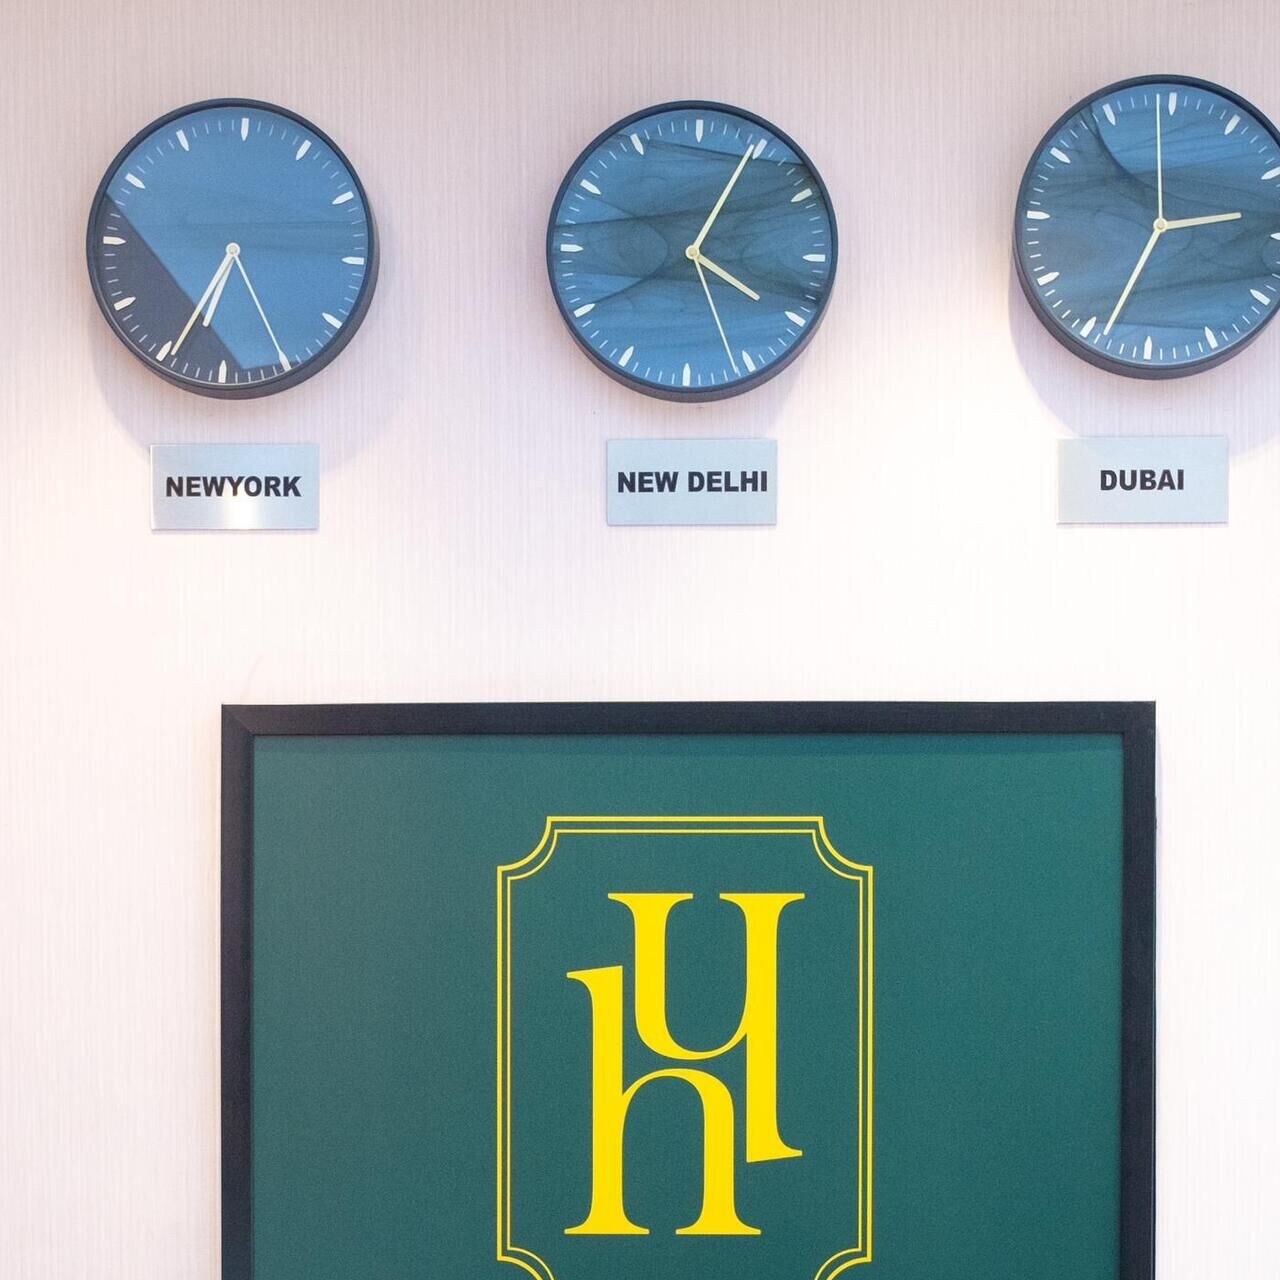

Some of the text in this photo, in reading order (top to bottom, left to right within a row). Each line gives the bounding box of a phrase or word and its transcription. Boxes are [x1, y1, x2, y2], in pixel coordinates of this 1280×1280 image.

[165, 475, 302, 498] NEWYORK
[616, 470, 769, 493] NEW DELHI
[1099, 469, 1185, 492] DUBAI
